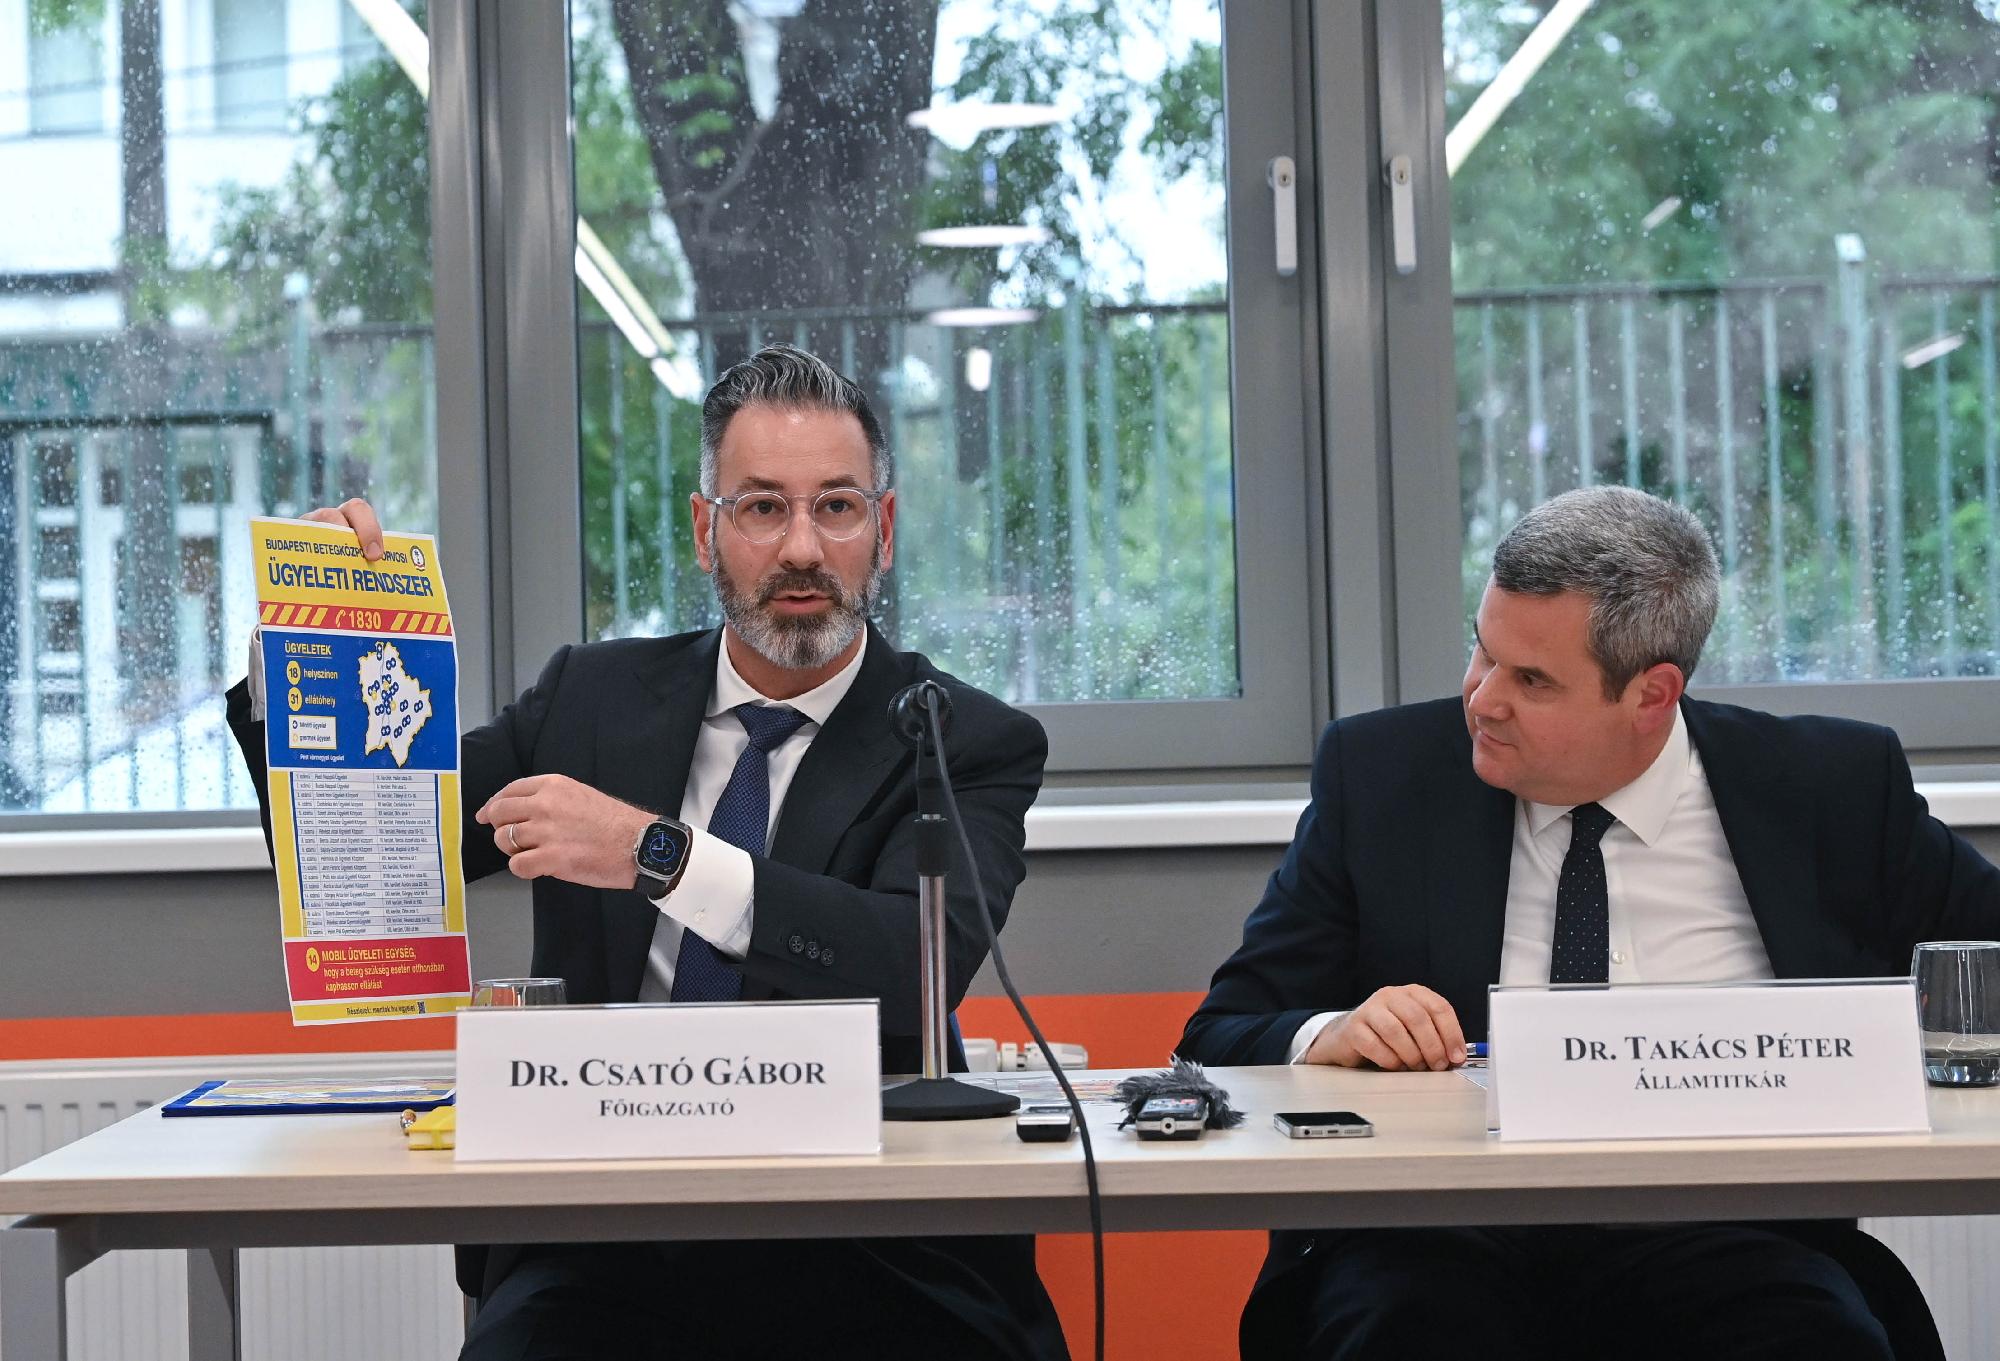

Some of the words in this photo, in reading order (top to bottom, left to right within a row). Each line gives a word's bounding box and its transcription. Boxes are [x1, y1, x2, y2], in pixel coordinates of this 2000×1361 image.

[265, 538, 312, 553] BUDAPESTI
[268, 556, 349, 590] ÜGYELETI
[353, 567, 434, 597] RENDSZER
[349, 611, 382, 629] 1830
[285, 640, 332, 655] ÜGYELETEK
[289, 668, 298, 678] 18
[303, 668, 338, 680] helyszínen
[291, 694, 299, 704] 31
[305, 695, 336, 708] ellátóhely
[309, 955, 317, 966] 14
[322, 950, 347, 962] MOBIL
[349, 946, 384, 961] ÜGYELETI
[385, 945, 417, 960] EGYSÉG,
[323, 967, 339, 979] hogy
[345, 966, 364, 978] beteg
